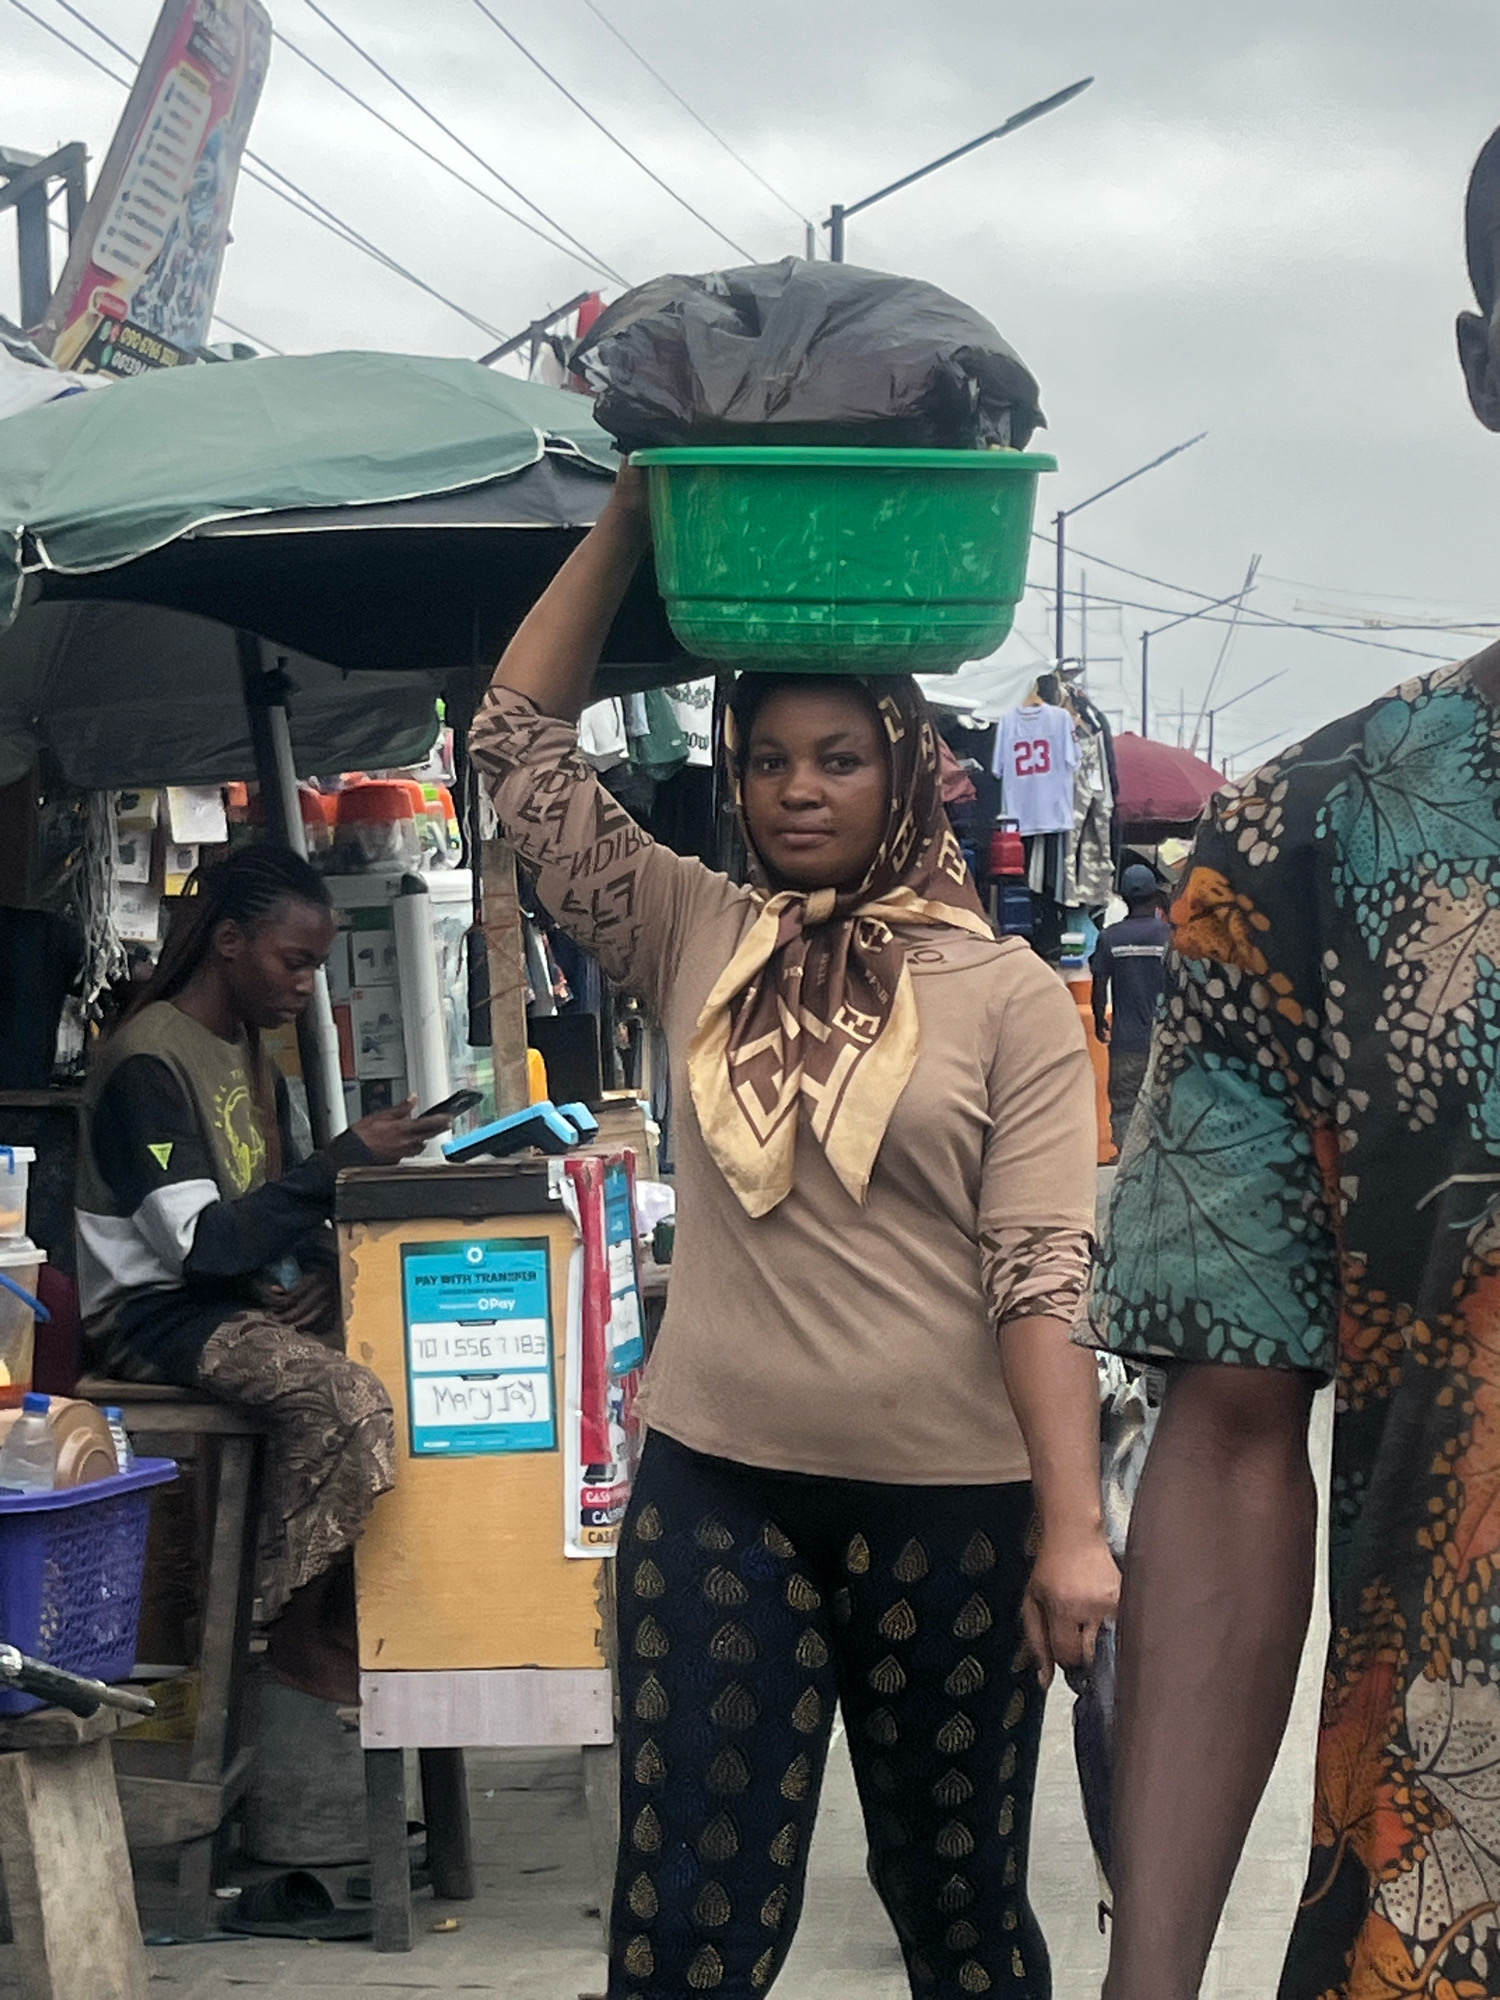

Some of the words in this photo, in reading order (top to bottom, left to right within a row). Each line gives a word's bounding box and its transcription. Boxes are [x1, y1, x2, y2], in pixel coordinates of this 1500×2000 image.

[1013, 738, 1051, 777] 23
[415, 1275, 438, 1286] PAY
[441, 1273, 472, 1285] WITH
[432, 1384, 493, 1421] Mary
